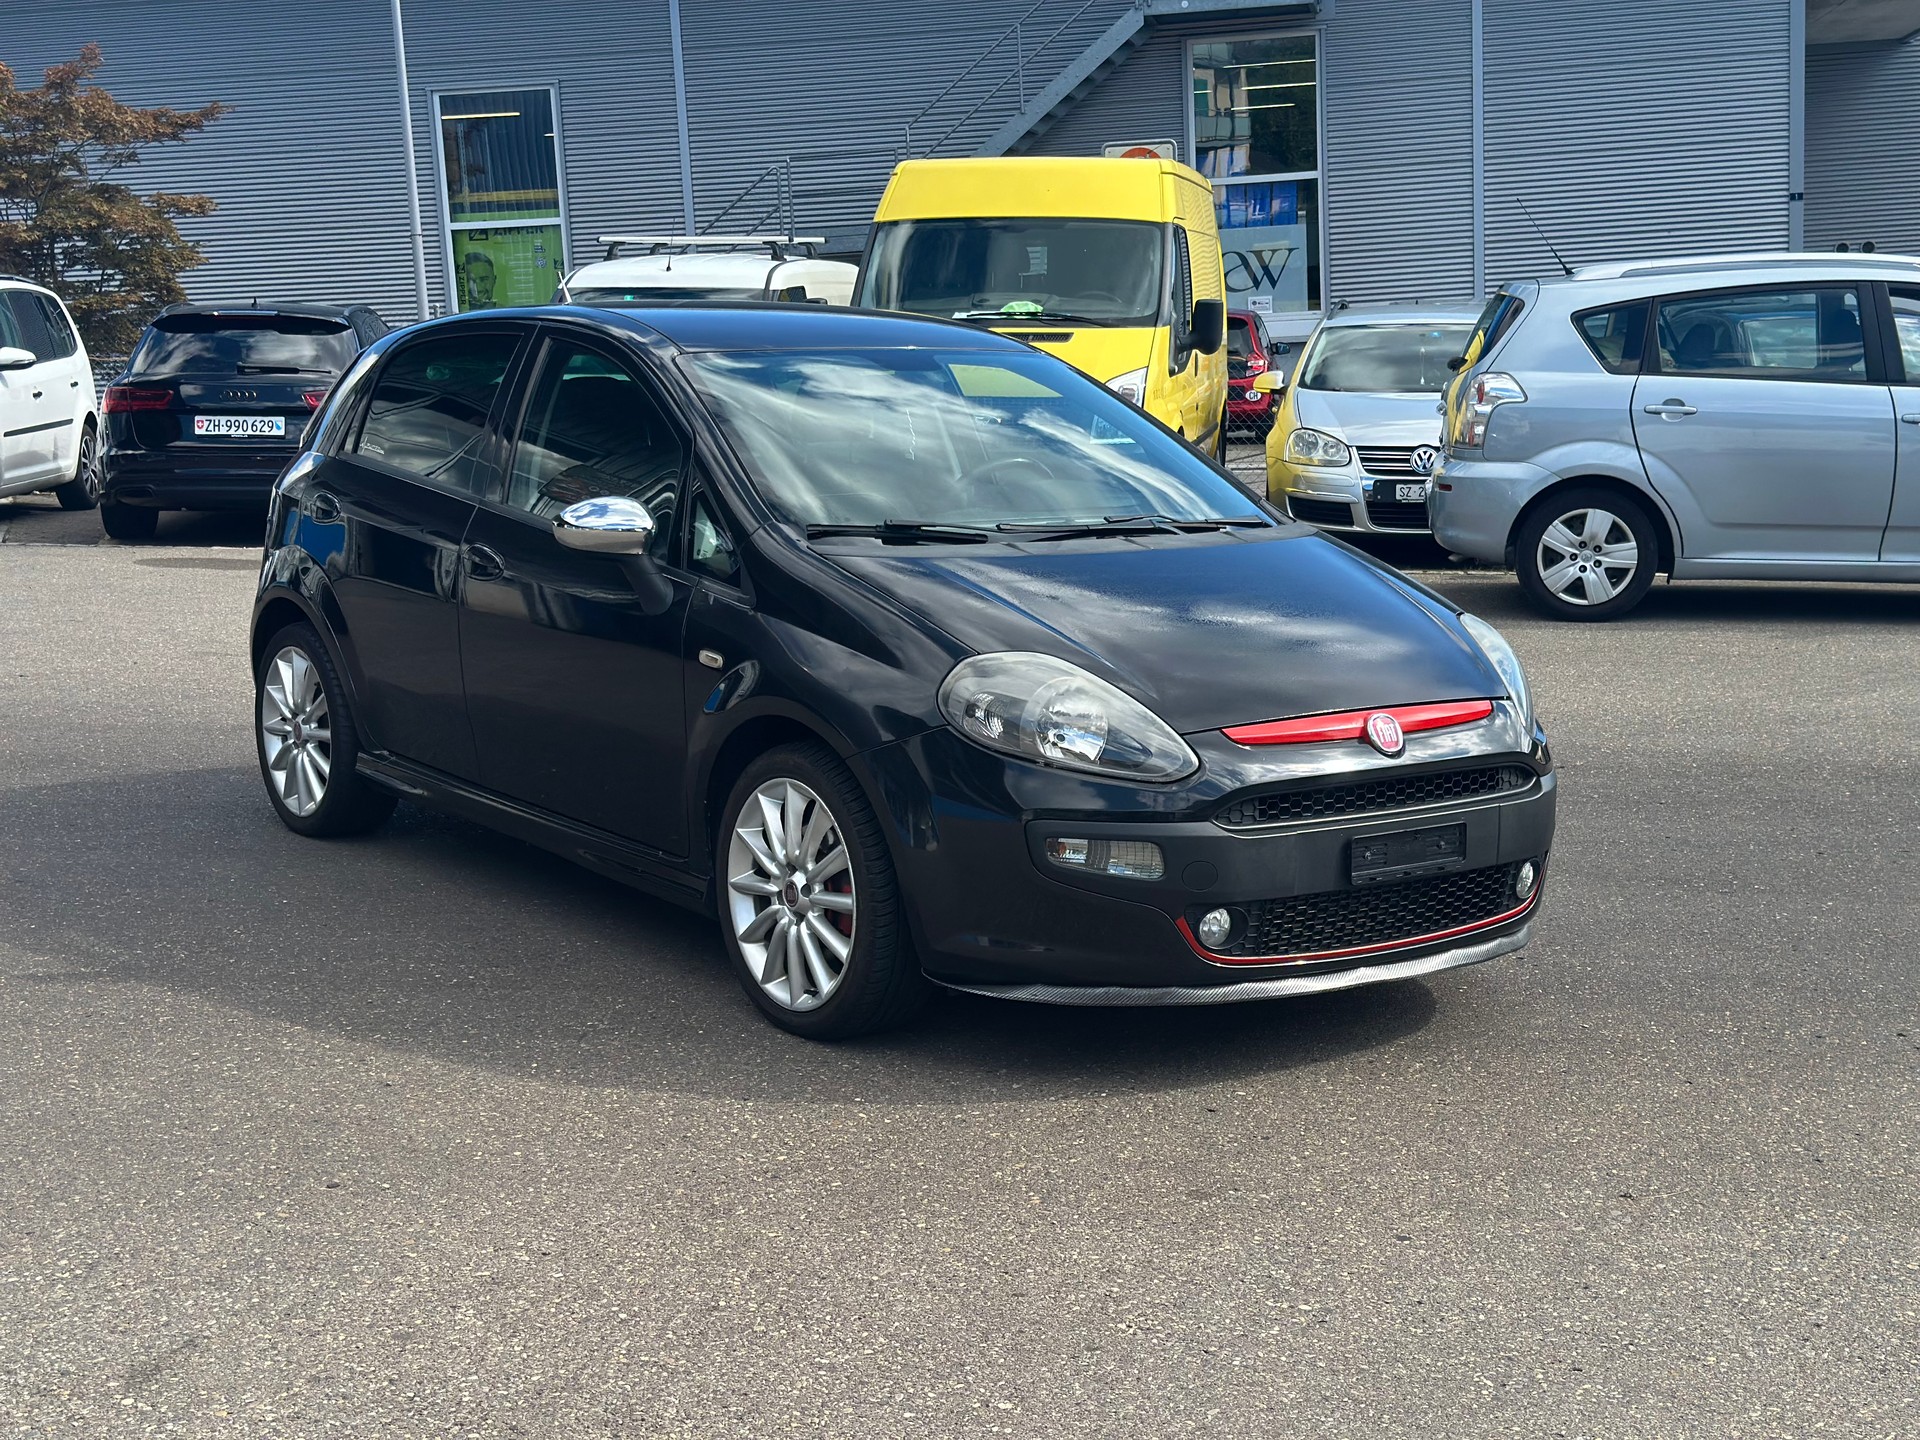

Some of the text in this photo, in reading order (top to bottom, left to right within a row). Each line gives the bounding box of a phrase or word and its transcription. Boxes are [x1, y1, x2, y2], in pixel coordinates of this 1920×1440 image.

[1249, 391, 1258, 400] CH
[1412, 449, 1437, 471] VW
[1376, 722, 1398, 743] FIAT
